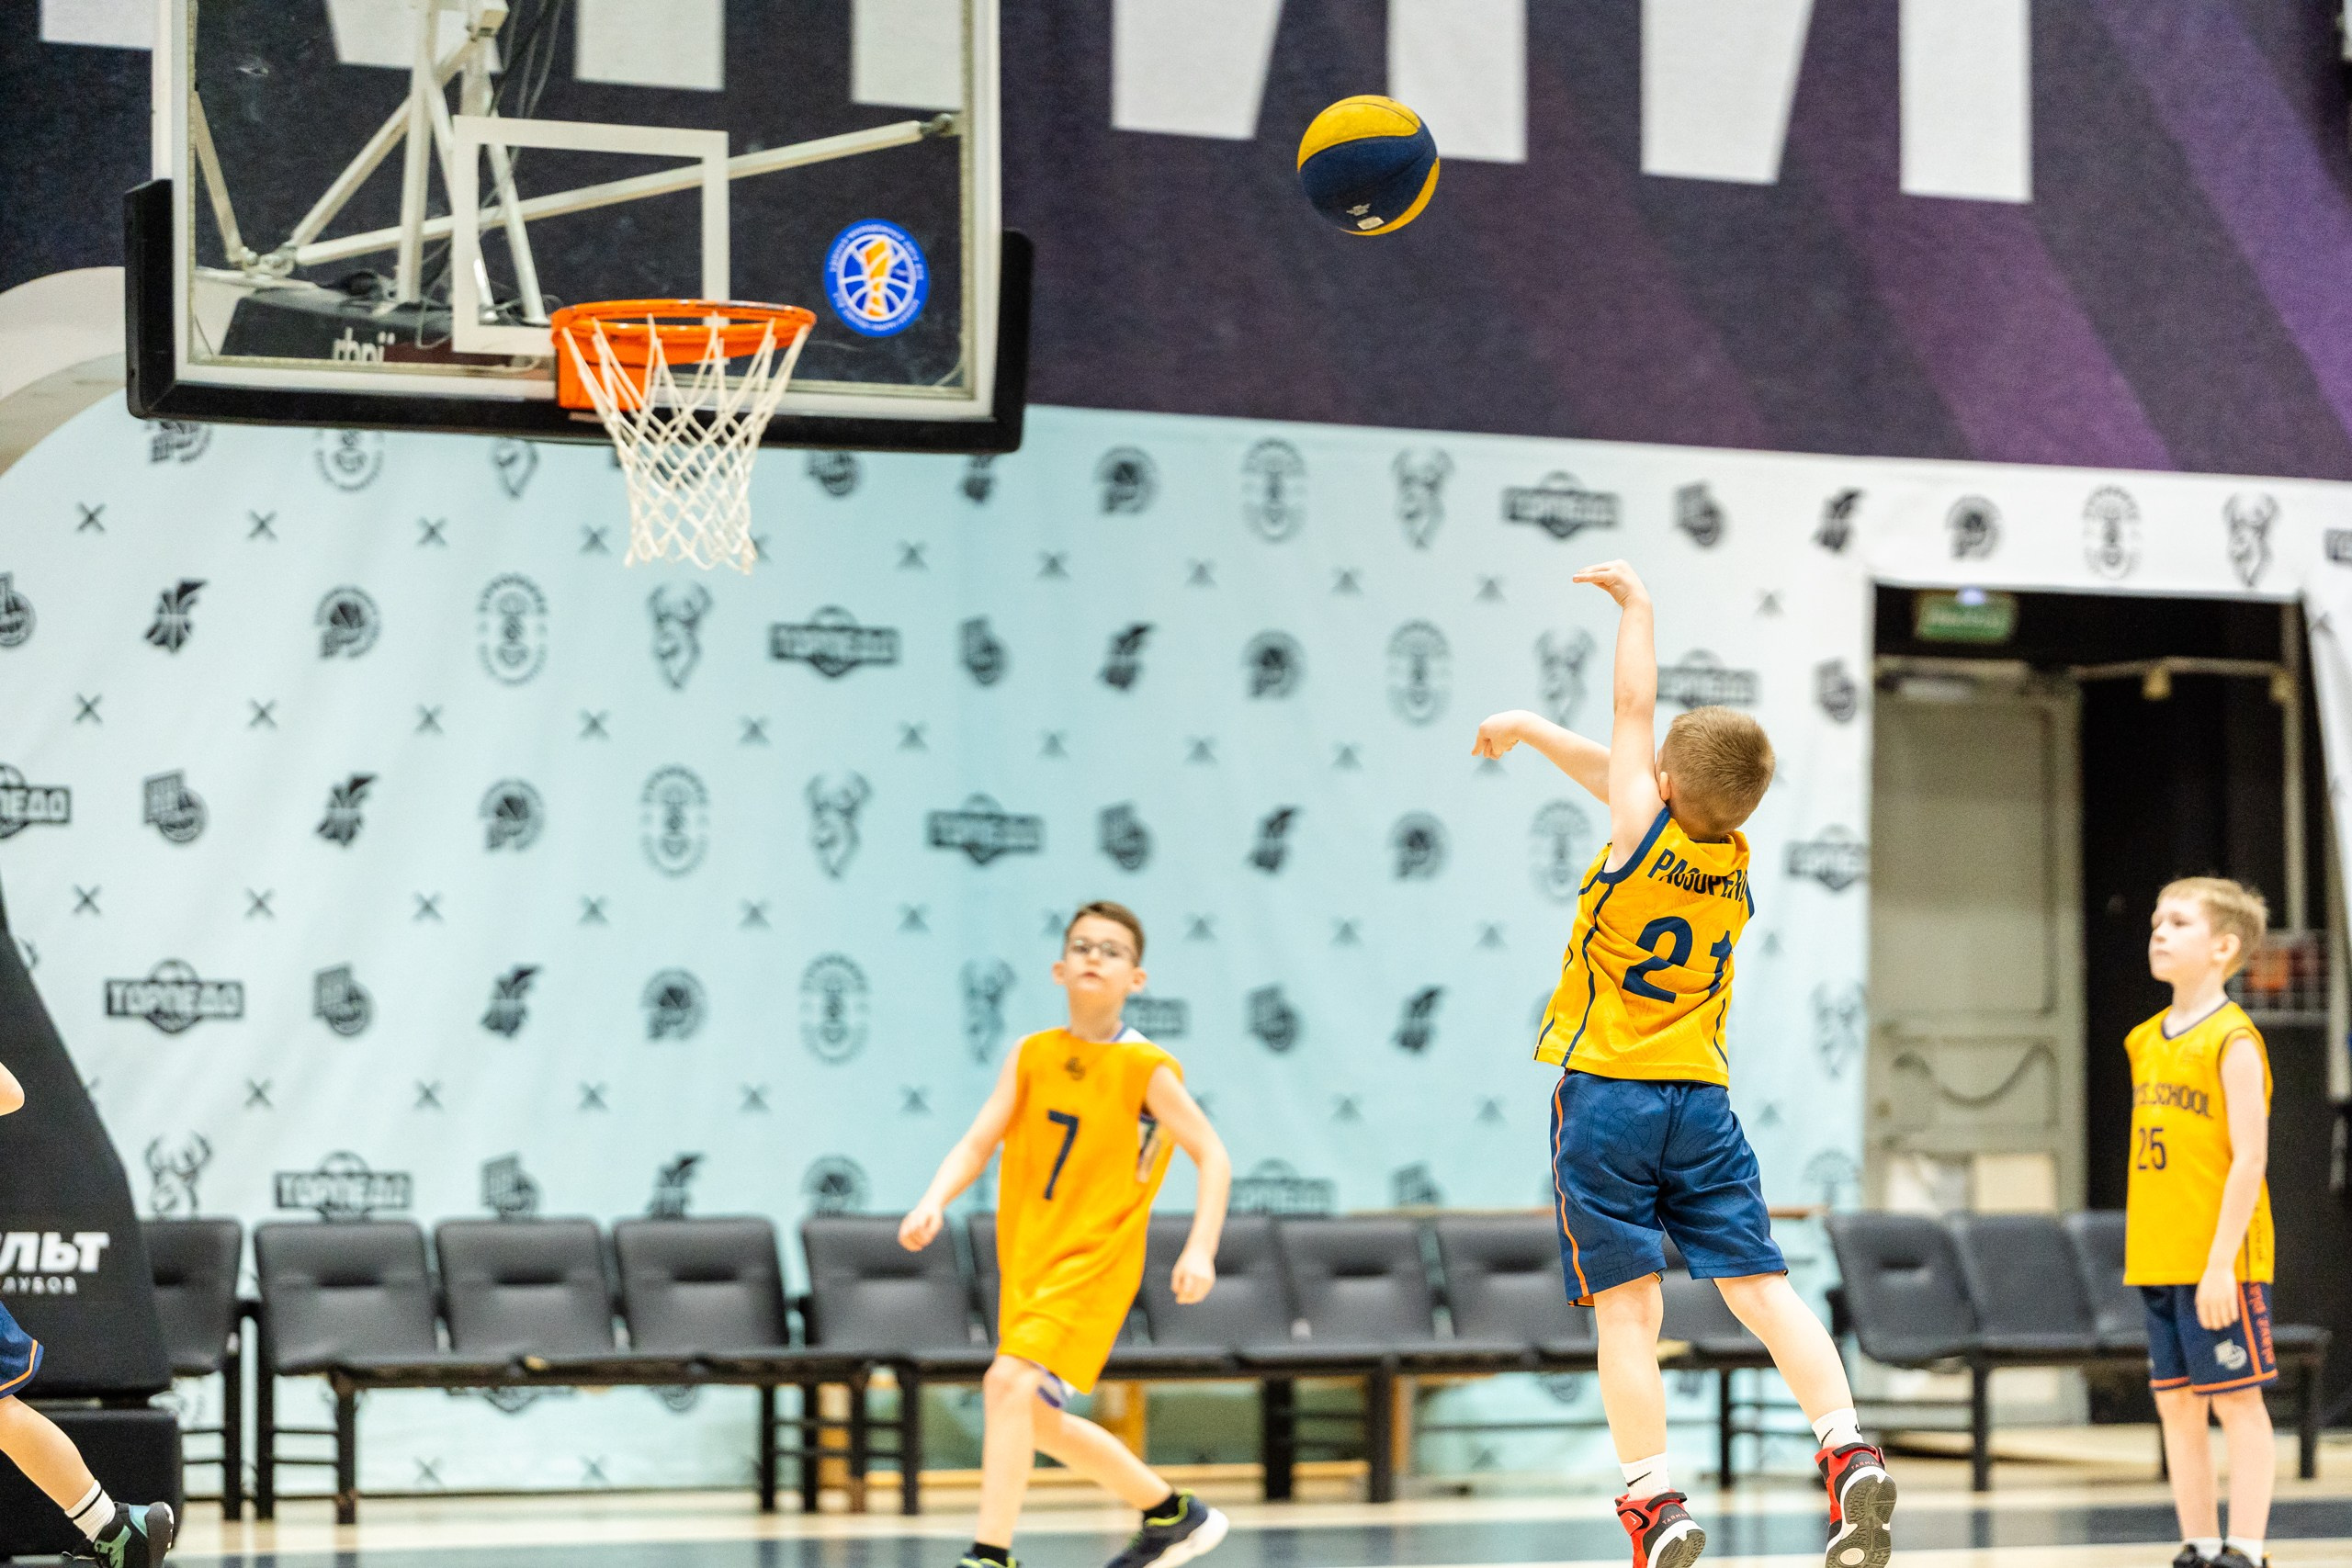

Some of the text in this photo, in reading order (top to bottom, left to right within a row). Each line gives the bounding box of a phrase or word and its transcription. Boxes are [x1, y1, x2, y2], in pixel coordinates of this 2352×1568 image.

[1622, 915, 1734, 1004] 21
[1044, 1110, 1080, 1201] 7
[2137, 1127, 2167, 1170] 25
[0, 1231, 110, 1274] ЛЬТ
